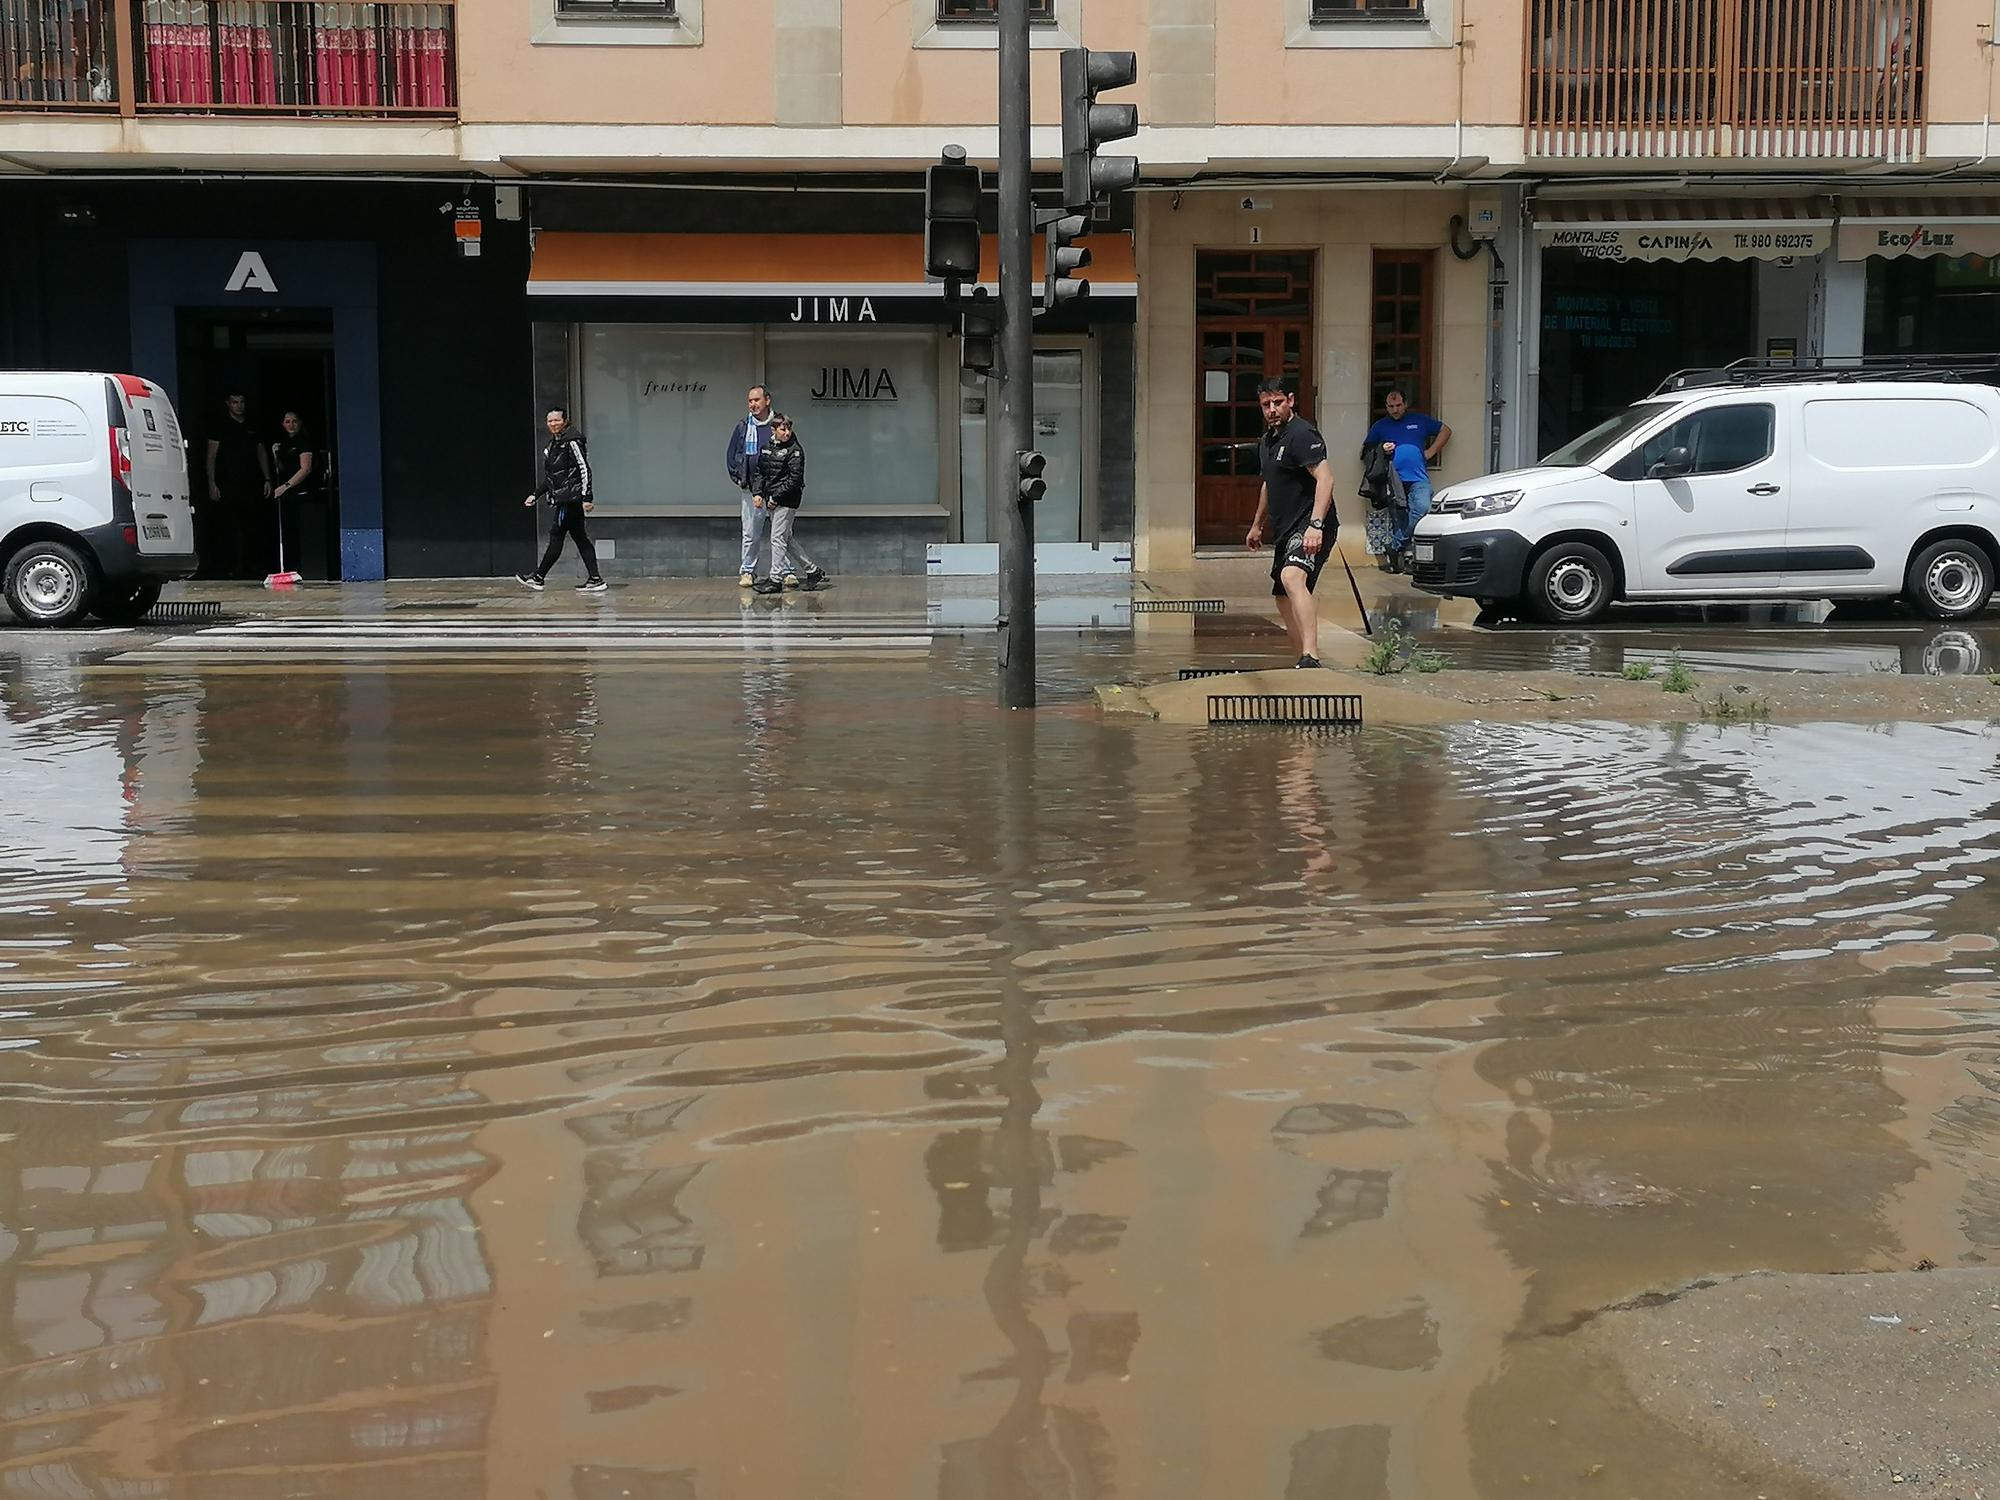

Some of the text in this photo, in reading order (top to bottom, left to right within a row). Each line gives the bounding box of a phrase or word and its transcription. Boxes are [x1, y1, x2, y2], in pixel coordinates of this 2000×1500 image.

[1553, 231, 1620, 243] MONTAJES
[1751, 234, 1771, 248] 980
[1775, 233, 1813, 249] 692375
[224, 251, 279, 292] A
[790, 297, 877, 322] JIMA
[1544, 315, 1558, 329] DE
[1565, 315, 1611, 330] MATERIAL
[811, 367, 898, 398] JIMA
